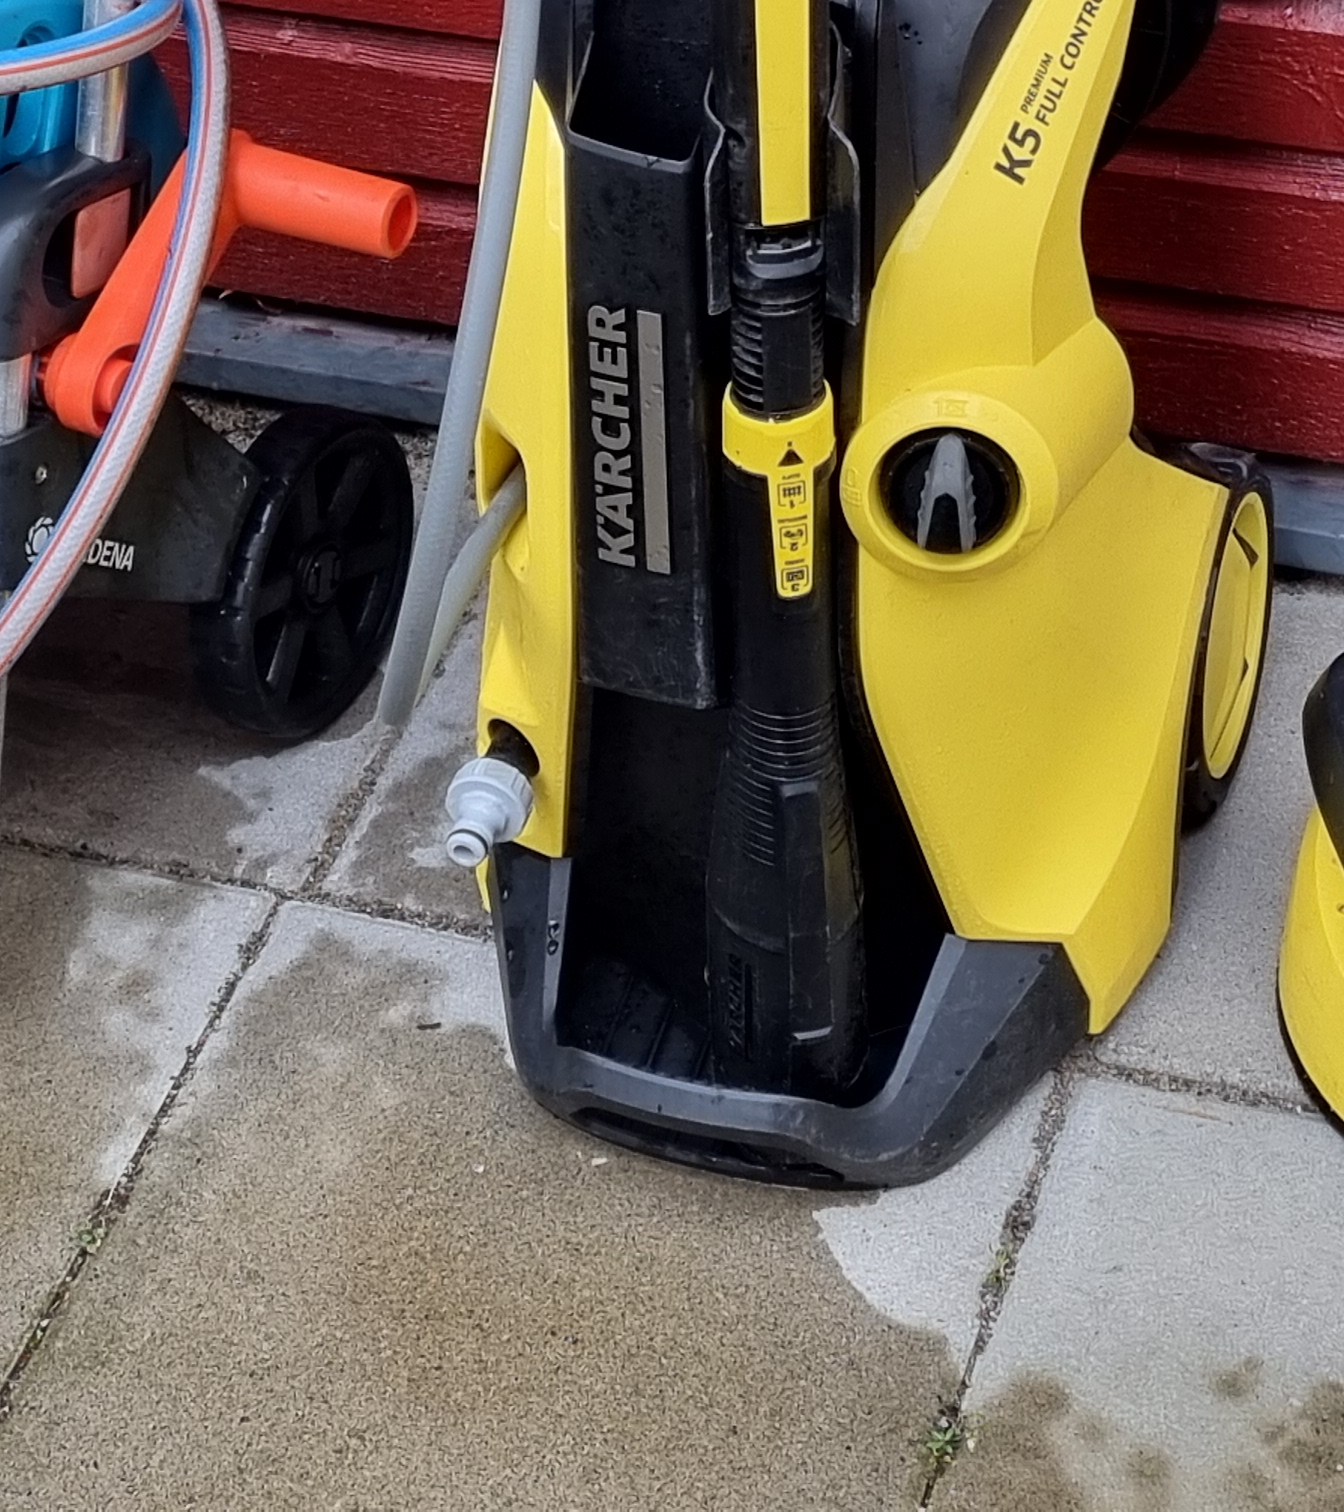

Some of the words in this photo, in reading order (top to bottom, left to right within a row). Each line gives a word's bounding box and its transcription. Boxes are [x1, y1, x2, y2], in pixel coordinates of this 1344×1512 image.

[993, 120, 1042, 186] K5
[1020, 52, 1053, 114] PREMIUM
[1034, 75, 1068, 126] FULL
[587, 305, 636, 567] KÄRCHER
[82, 538, 135, 571] DENA
